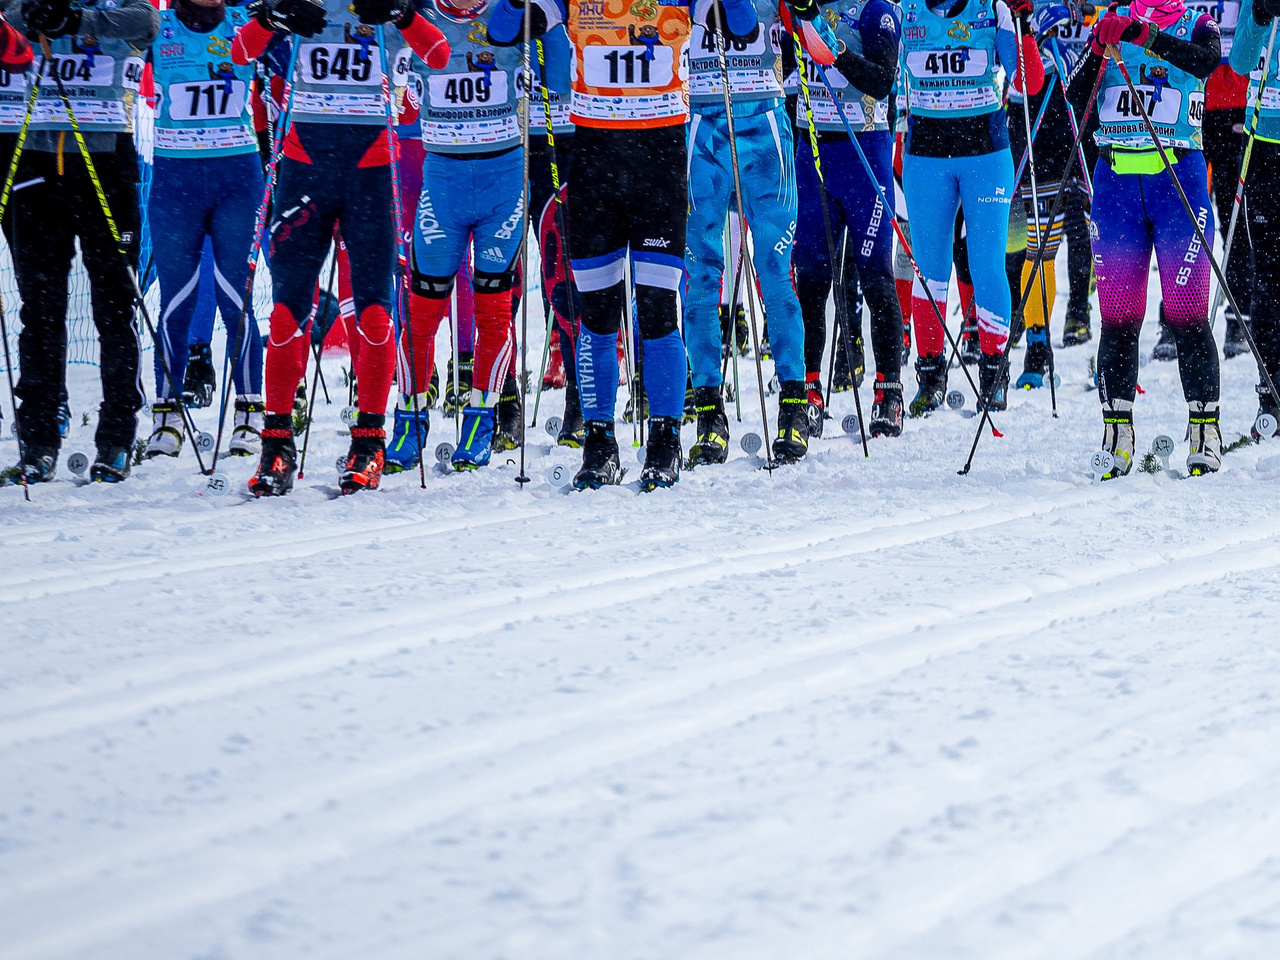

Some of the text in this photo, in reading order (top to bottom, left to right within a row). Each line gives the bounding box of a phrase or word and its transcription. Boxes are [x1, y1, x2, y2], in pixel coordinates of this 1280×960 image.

[948, 20, 973, 41] 25
[310, 47, 373, 82] 645
[603, 50, 651, 84] 111
[691, 59, 729, 71] Ястребв
[925, 52, 966, 75] 416
[185, 84, 230, 116] 717
[445, 77, 491, 103] 409
[1116, 90, 1156, 118] 407
[1175, 266, 1192, 287] 65
[578, 332, 598, 410] SAKHALIN
[437, 448, 450, 460] 13
[553, 466, 563, 481] 6
